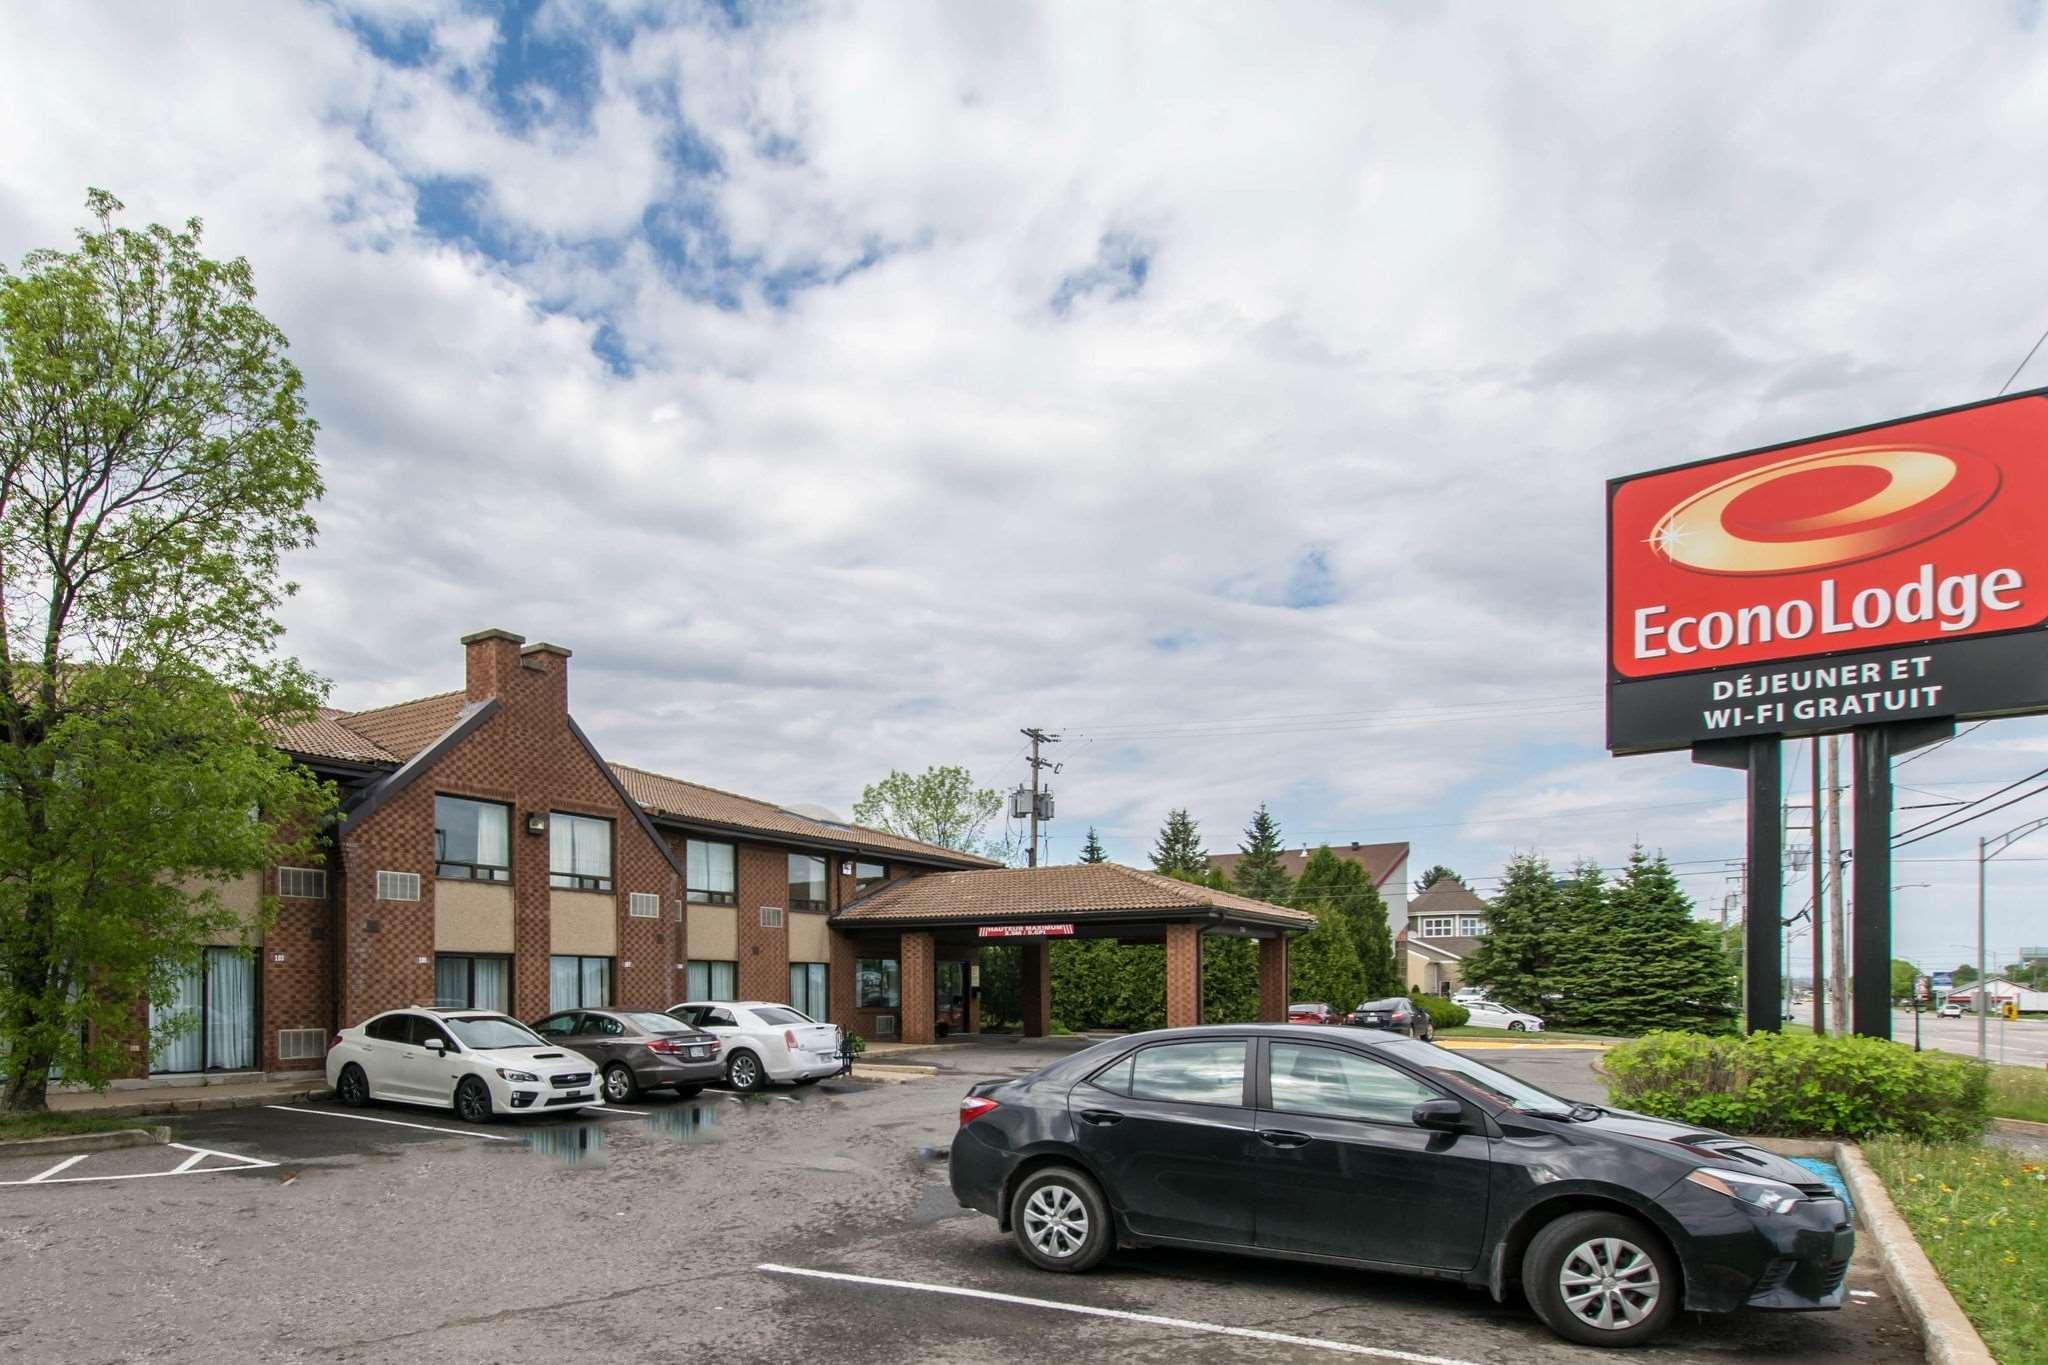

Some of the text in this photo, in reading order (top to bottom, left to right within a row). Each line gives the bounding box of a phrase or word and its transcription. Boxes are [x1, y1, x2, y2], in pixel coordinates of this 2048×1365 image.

[1712, 656, 1933, 702] DÉJEUNER ET
[1703, 685, 1943, 730] WI-FI GRATUIT
